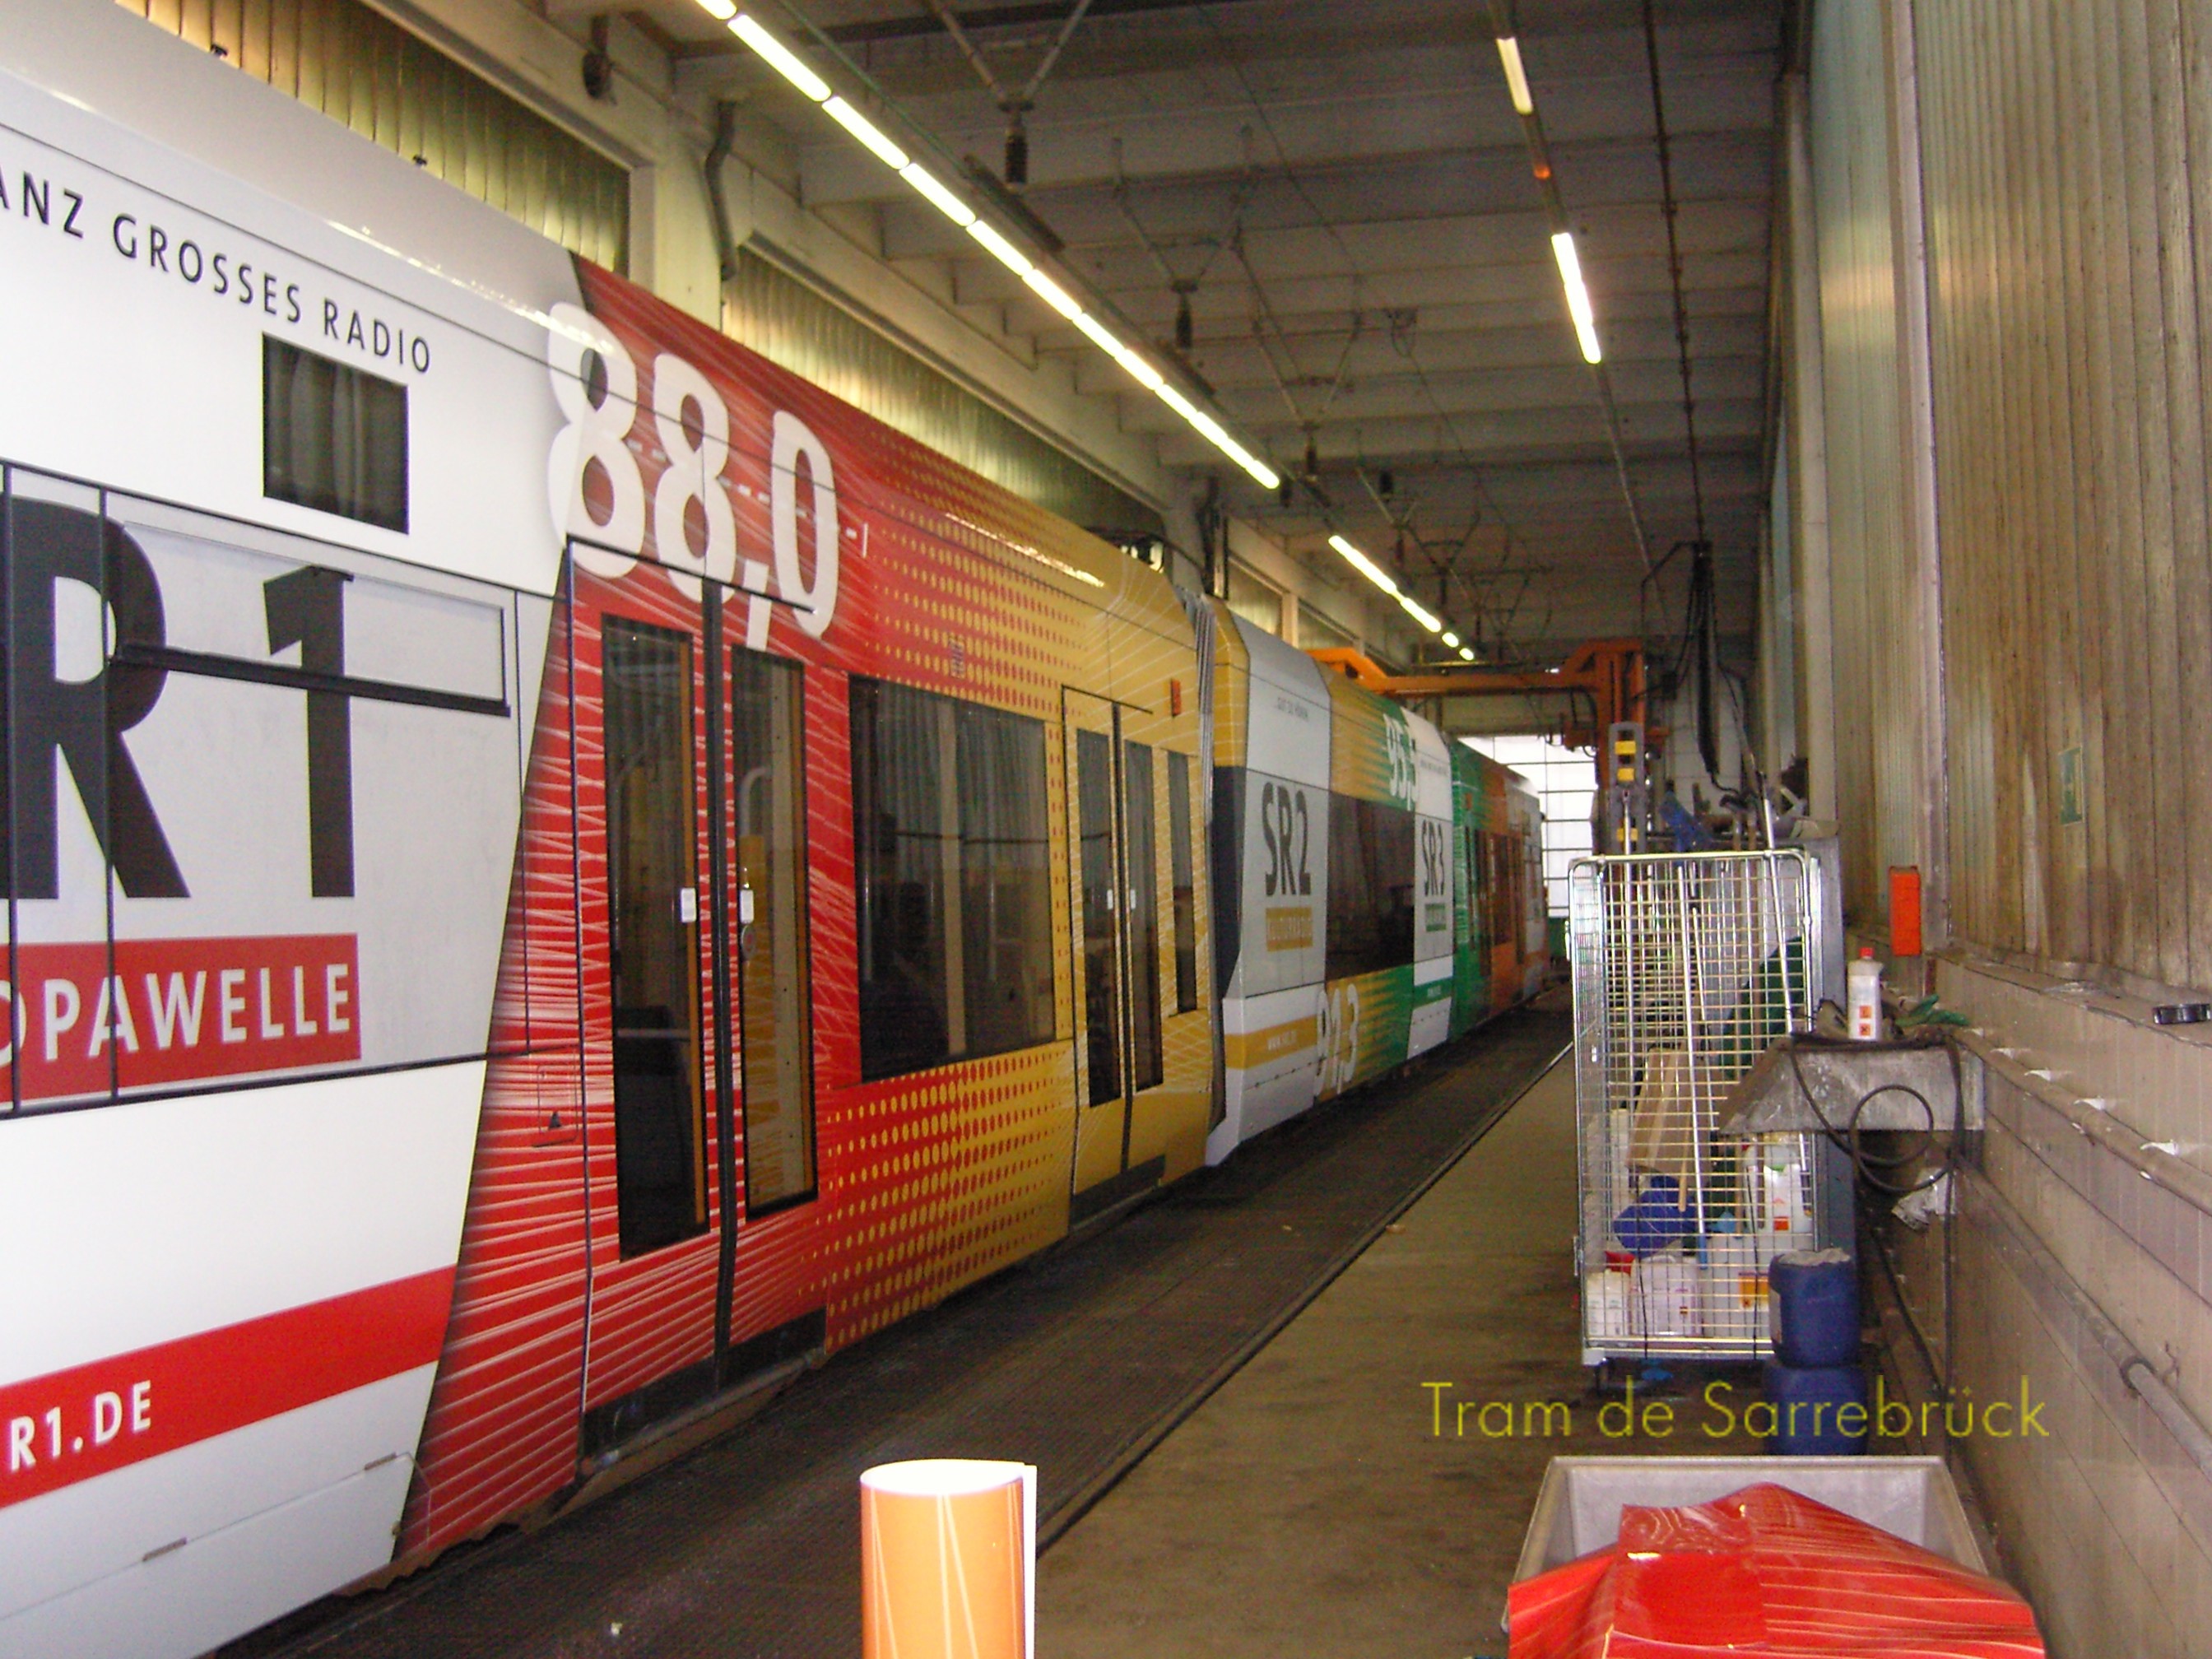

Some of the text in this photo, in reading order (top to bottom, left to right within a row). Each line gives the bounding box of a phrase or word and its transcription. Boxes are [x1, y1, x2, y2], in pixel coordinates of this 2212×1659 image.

[113, 212, 300, 323] GROSSES
[324, 298, 430, 374] RADIO
[547, 301, 839, 650] 88,0
[1262, 781, 1312, 897] SR2
[1421, 819, 1445, 898] SR3
[1313, 983, 1359, 1096] 91,3
[10, 1379, 151, 1473] R1.DE
